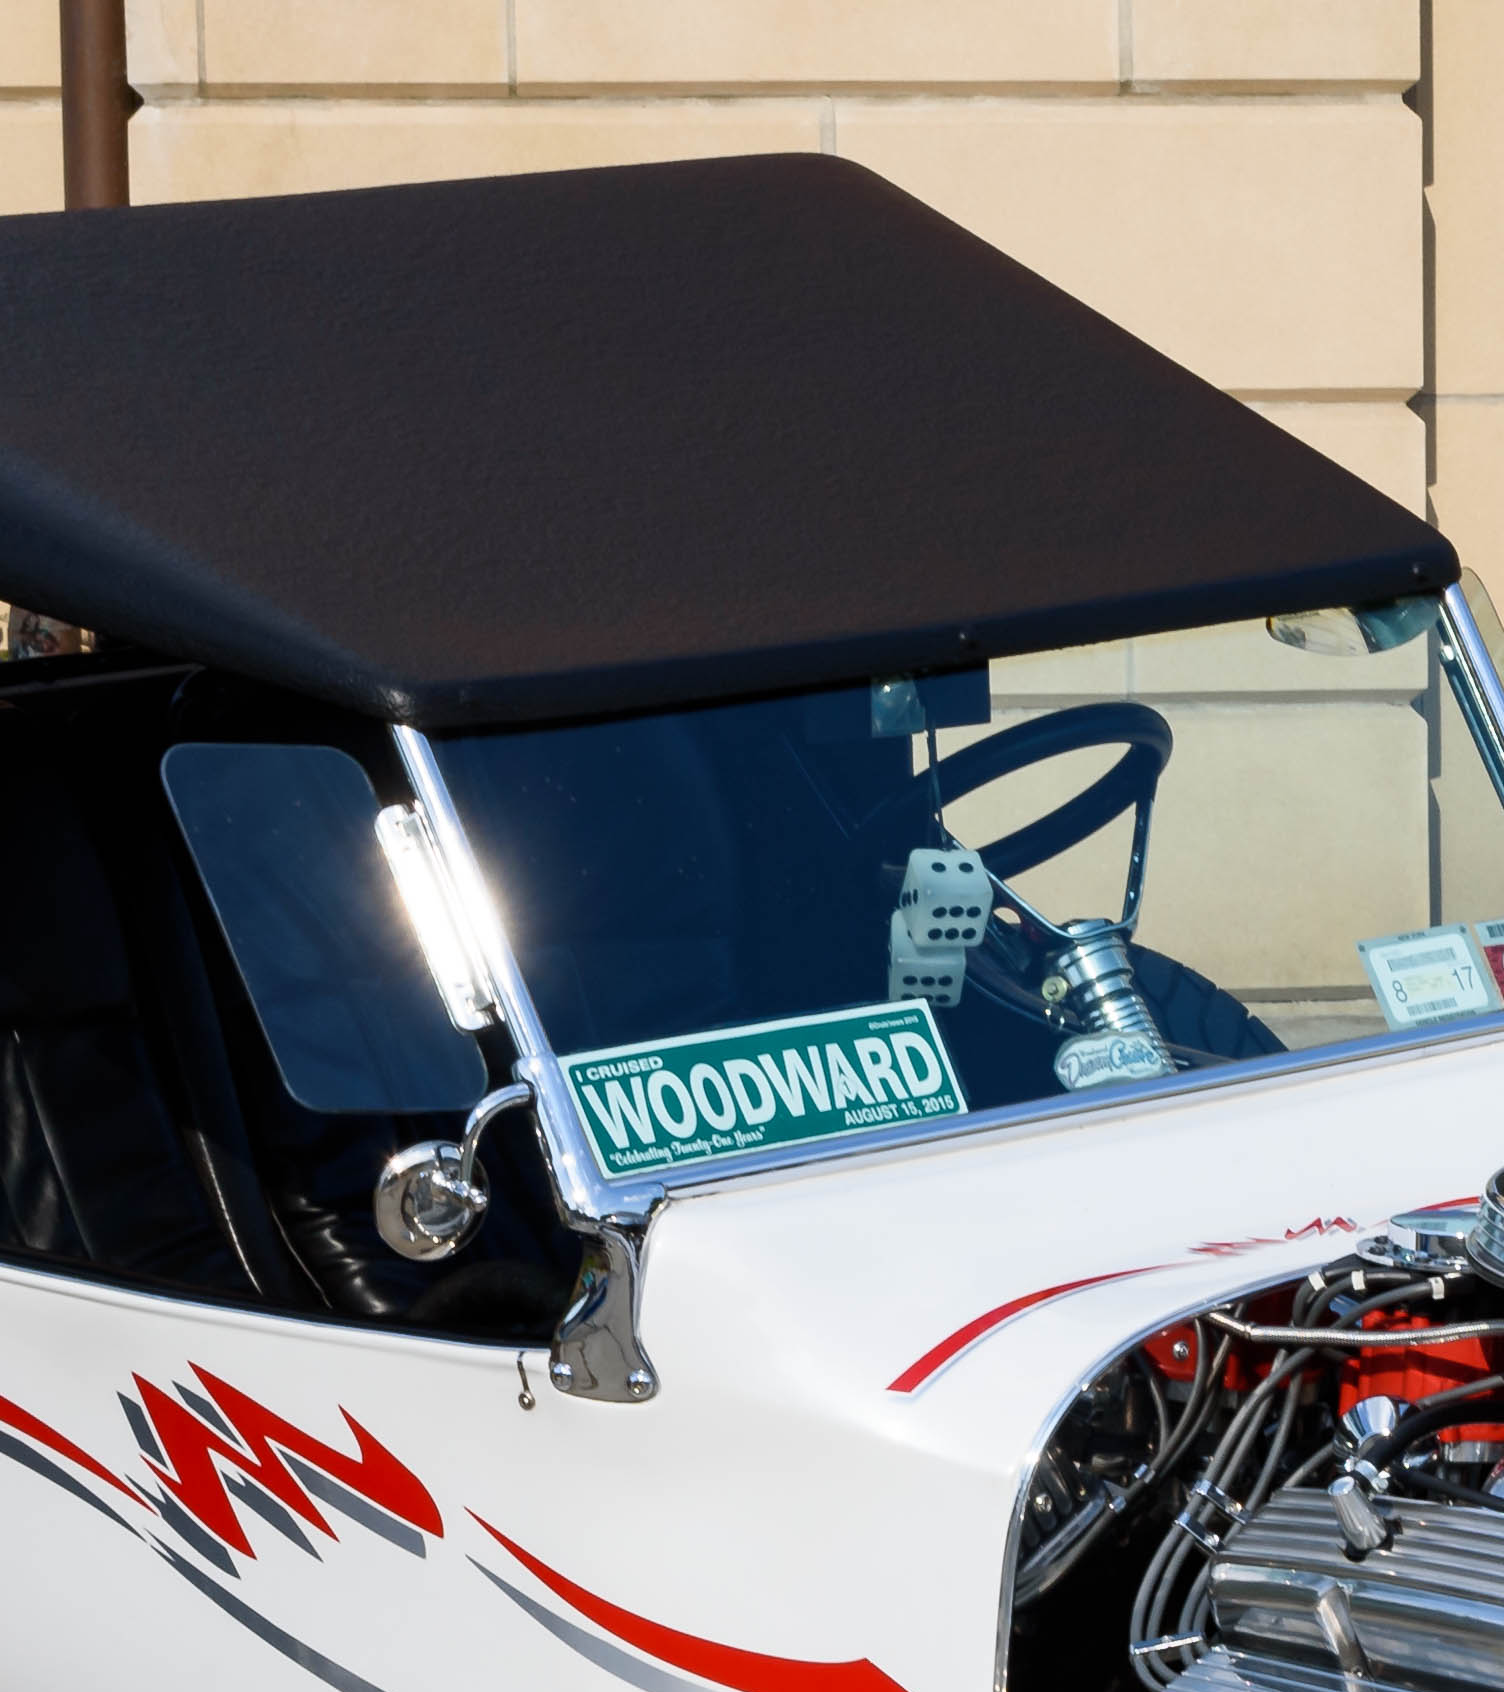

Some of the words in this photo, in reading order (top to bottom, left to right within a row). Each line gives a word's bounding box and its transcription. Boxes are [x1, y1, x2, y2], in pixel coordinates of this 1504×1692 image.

[1392, 980, 1408, 1003] 8
[1452, 966, 1474, 992] 17
[575, 1070, 583, 1083] I
[586, 1056, 663, 1080] CRUISED
[581, 1031, 944, 1149] WOODWARD
[844, 1103, 899, 1126] AUGUST
[900, 1100, 922, 1117] 15,
[922, 1094, 955, 1113] 2015
